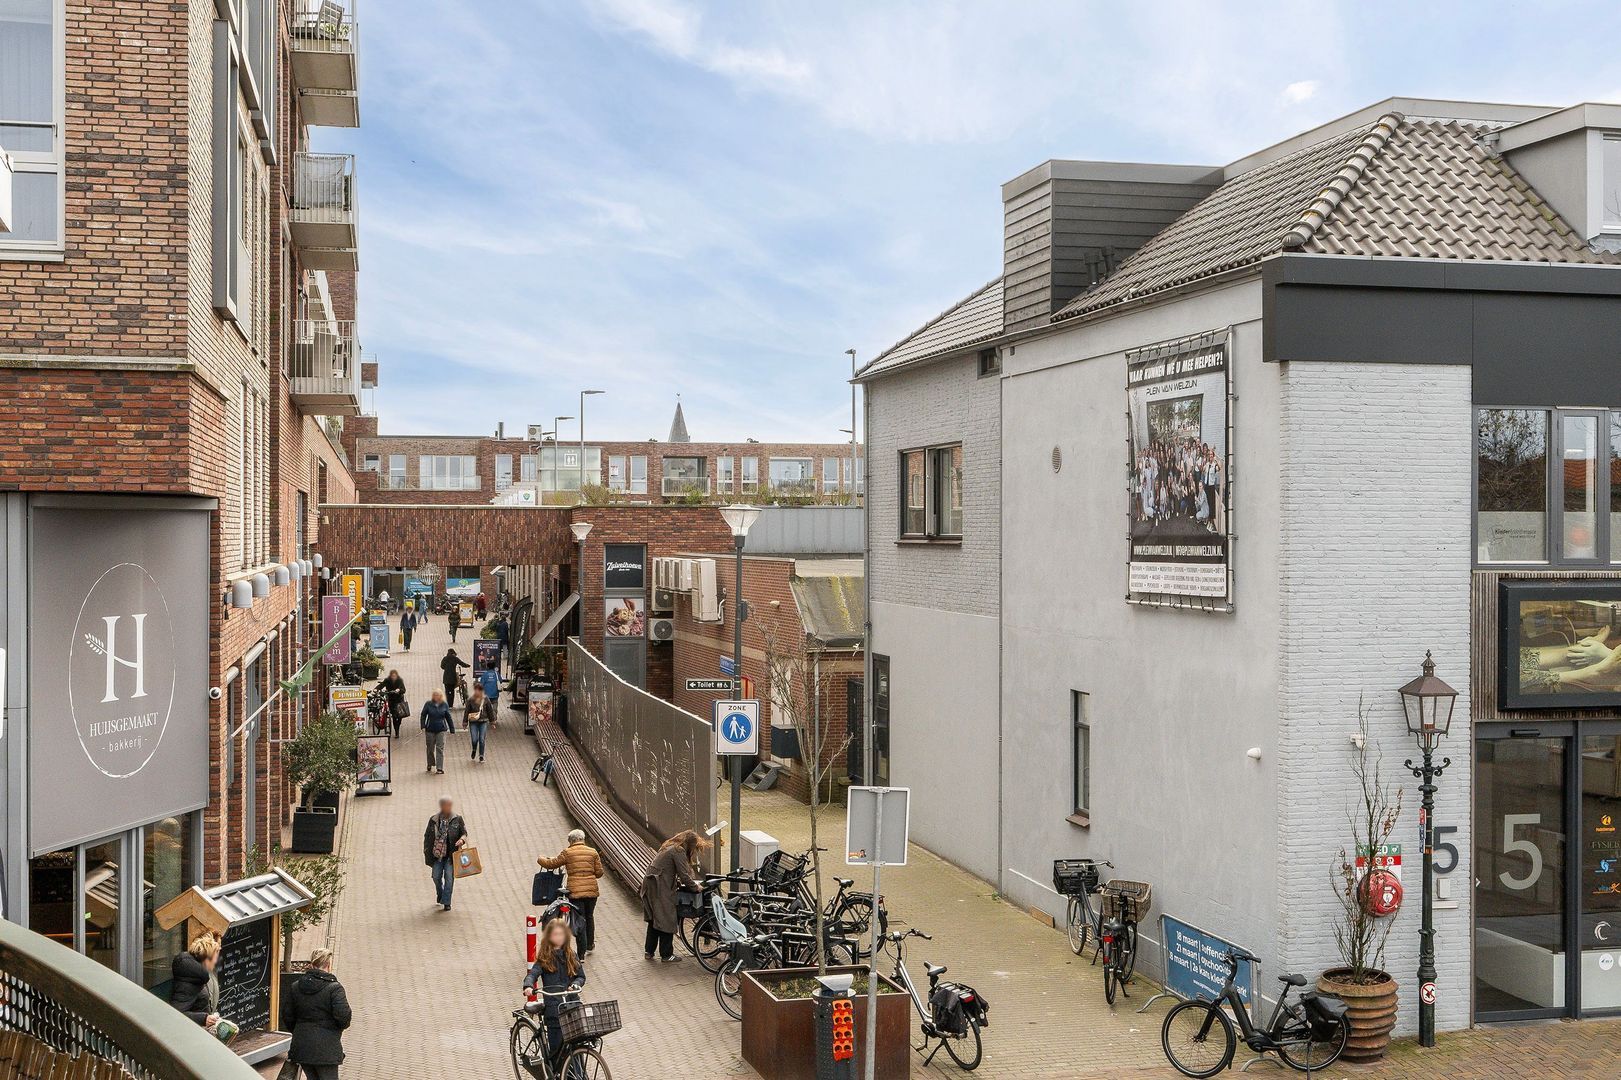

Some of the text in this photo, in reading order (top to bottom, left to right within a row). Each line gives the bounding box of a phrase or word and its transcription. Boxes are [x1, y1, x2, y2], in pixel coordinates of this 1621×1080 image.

[1167, 361, 1175, 375] WE
[1176, 361, 1181, 373] U
[1182, 358, 1193, 373] MEE
[332, 605, 341, 655] Bloeem
[697, 681, 714, 689] Toilet
[89, 712, 159, 738] HUIJSGEMAAKT
[109, 736, 143, 753] bakkerij
[1432, 826, 1459, 874] 5
[1499, 813, 1543, 890] 5
[1183, 934, 1198, 949] maart
[1176, 943, 1182, 952] 21
[1182, 946, 1198, 961] maart
[1174, 955, 1189, 969] maart
